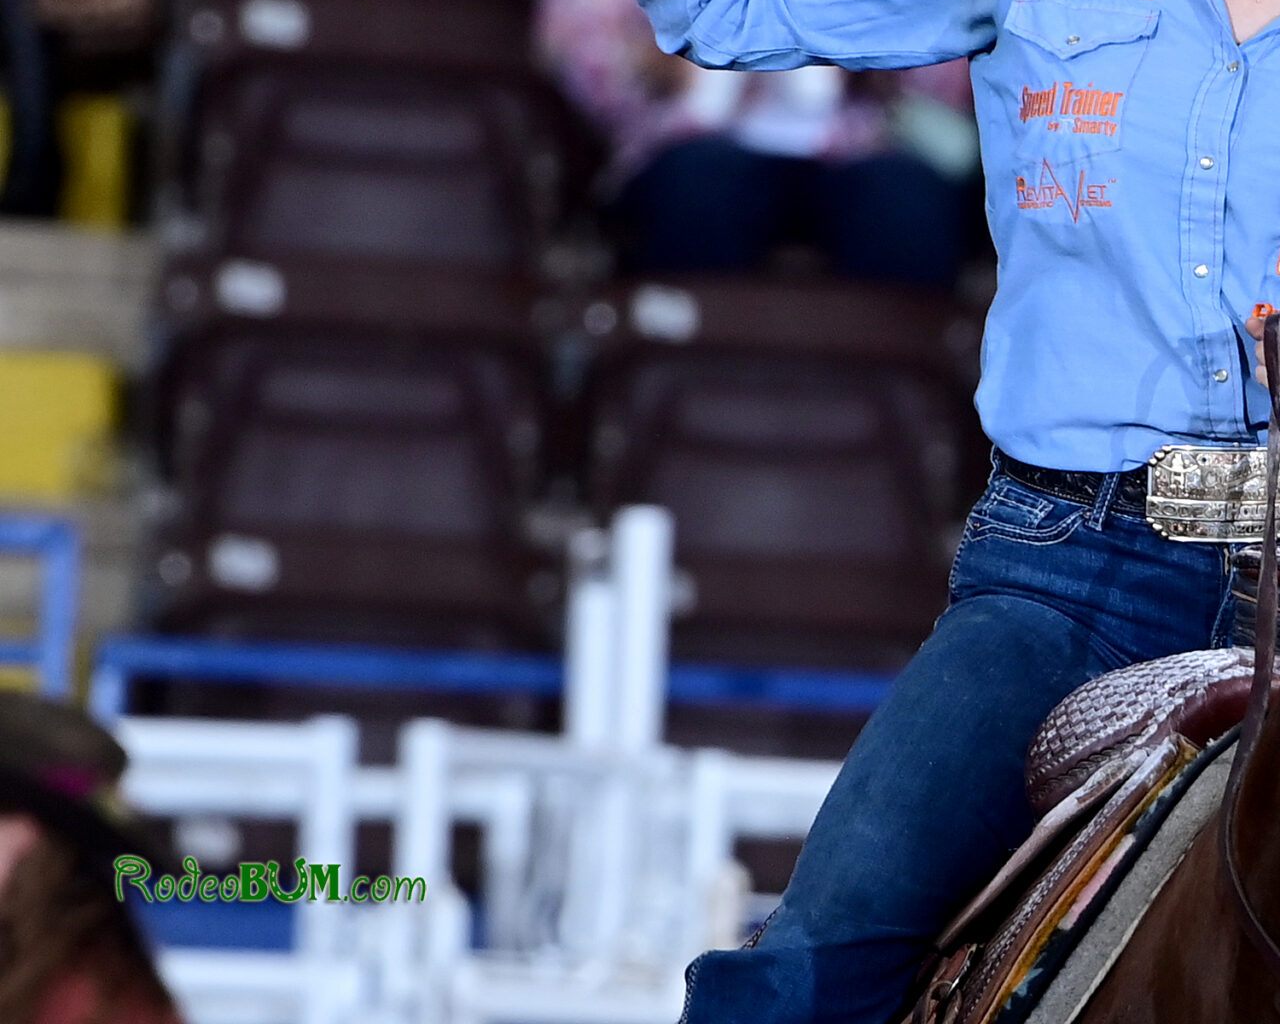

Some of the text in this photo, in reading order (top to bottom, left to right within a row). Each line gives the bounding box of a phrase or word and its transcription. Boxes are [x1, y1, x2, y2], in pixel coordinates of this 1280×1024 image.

[1019, 81, 1124, 123] Speed Trainer
[1073, 117, 1118, 136] Smarty
[1235, 524, 1267, 534] 202
